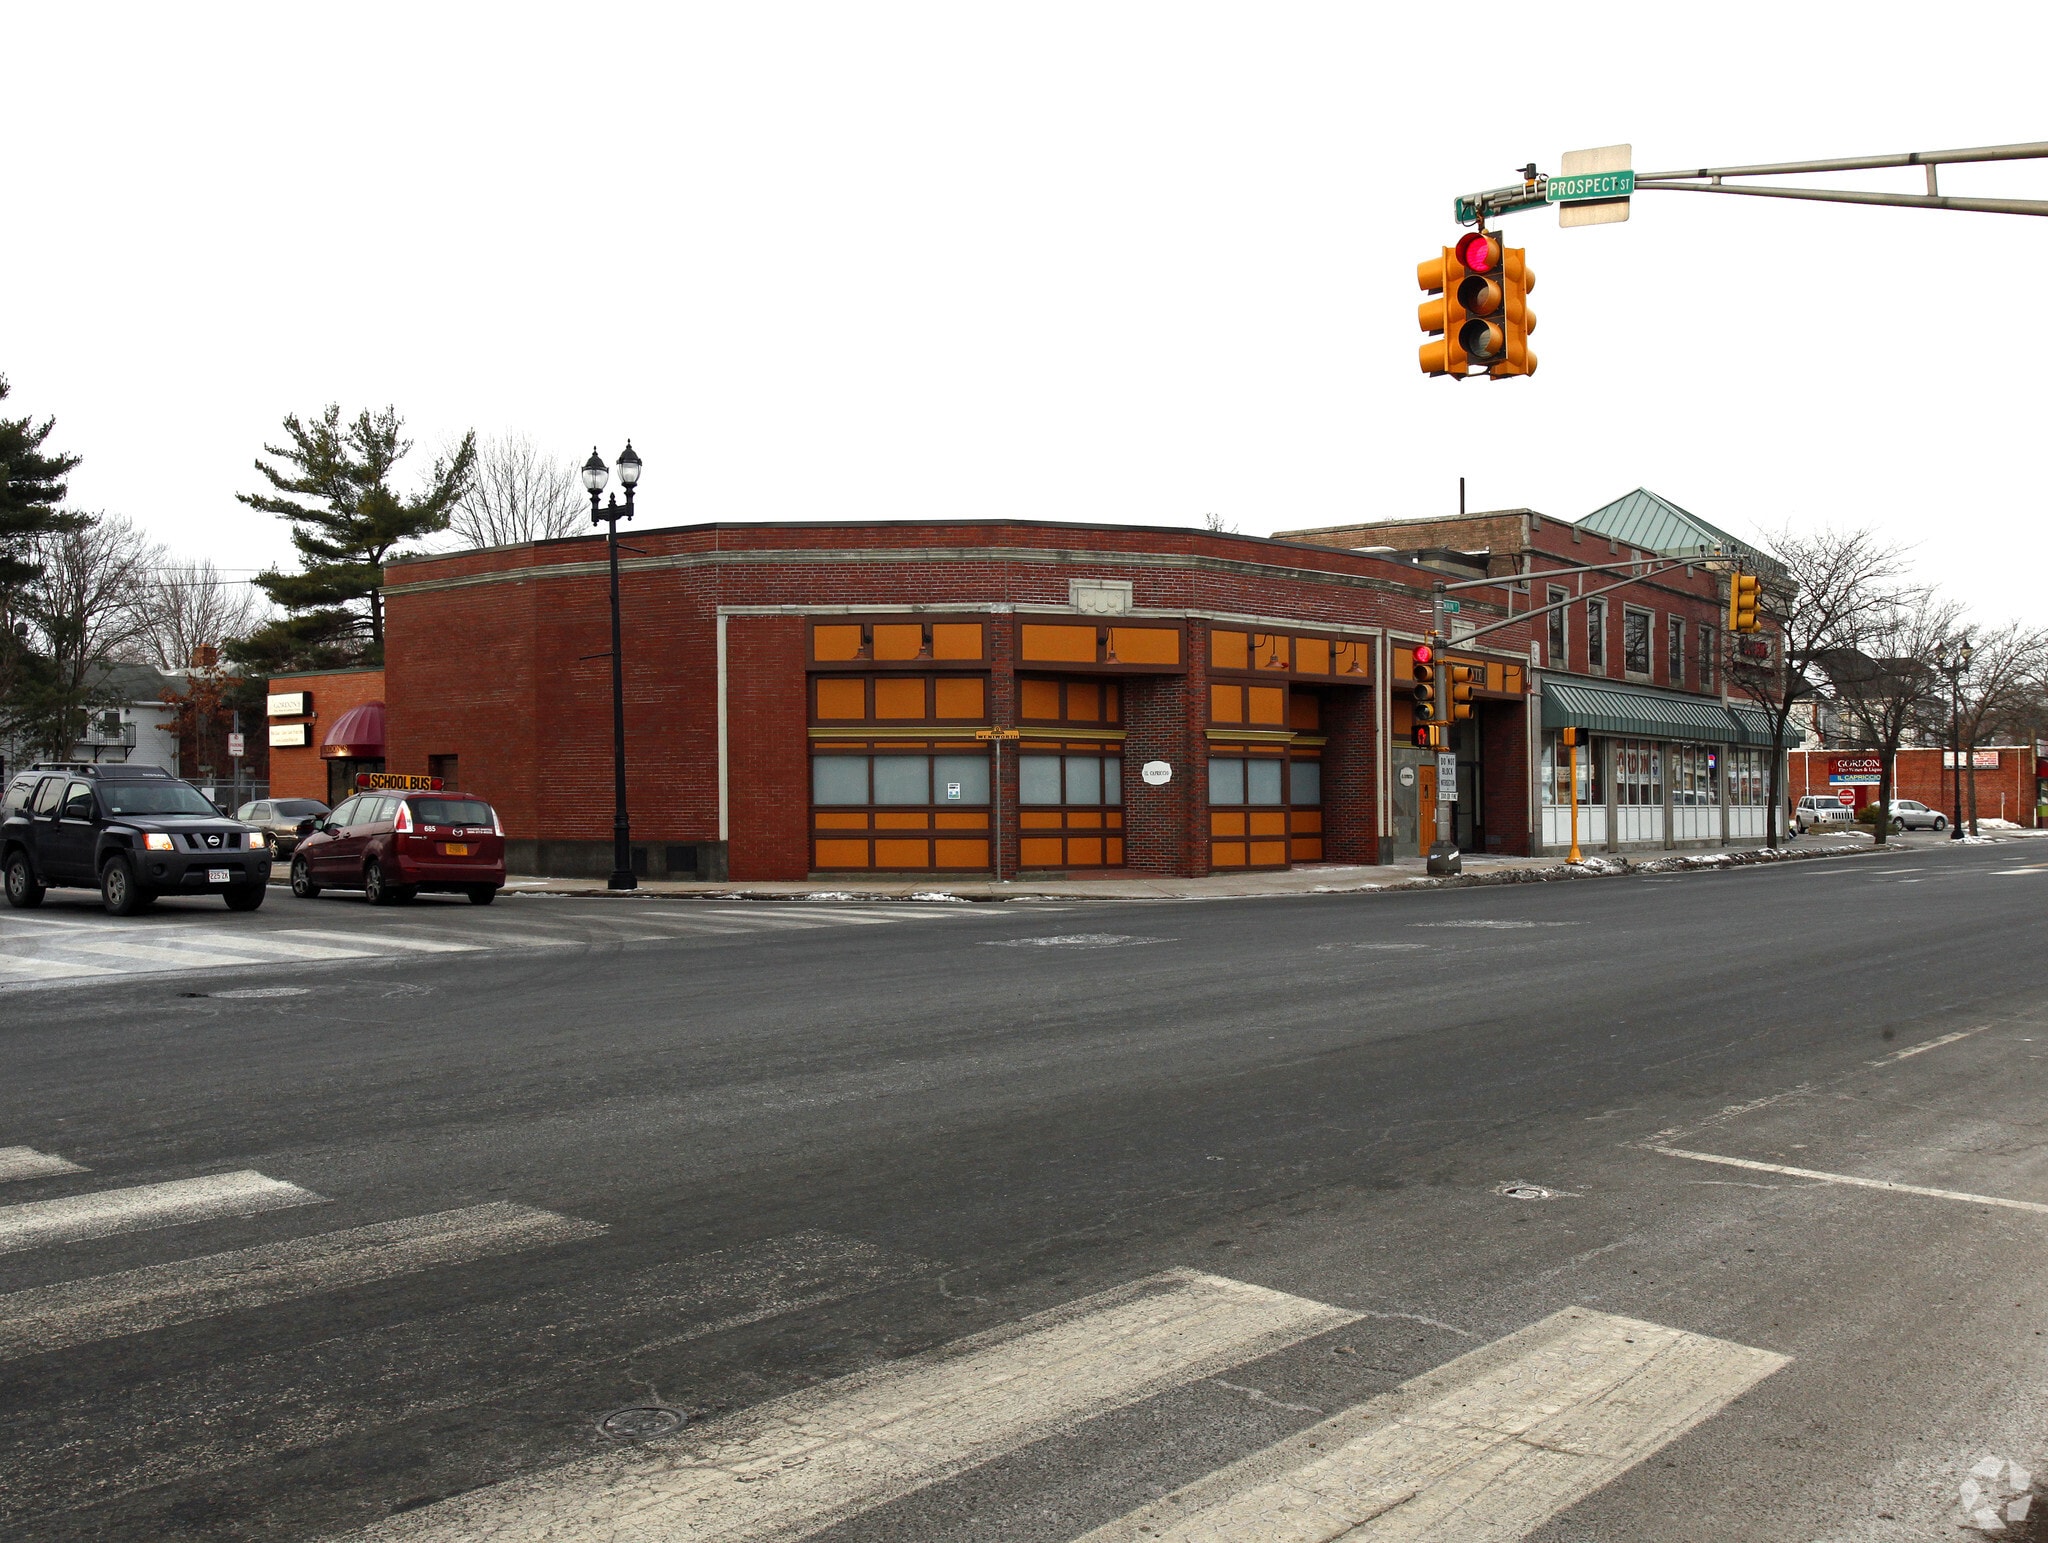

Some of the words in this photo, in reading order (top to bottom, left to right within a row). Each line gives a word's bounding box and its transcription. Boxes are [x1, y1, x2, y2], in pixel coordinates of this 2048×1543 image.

[1549, 176, 1618, 197] PROSPECT
[1620, 178, 1631, 191] ST
[1441, 767, 1453, 776] BLOCK
[371, 774, 408, 790] SCHOOL
[410, 776, 430, 791] BUS
